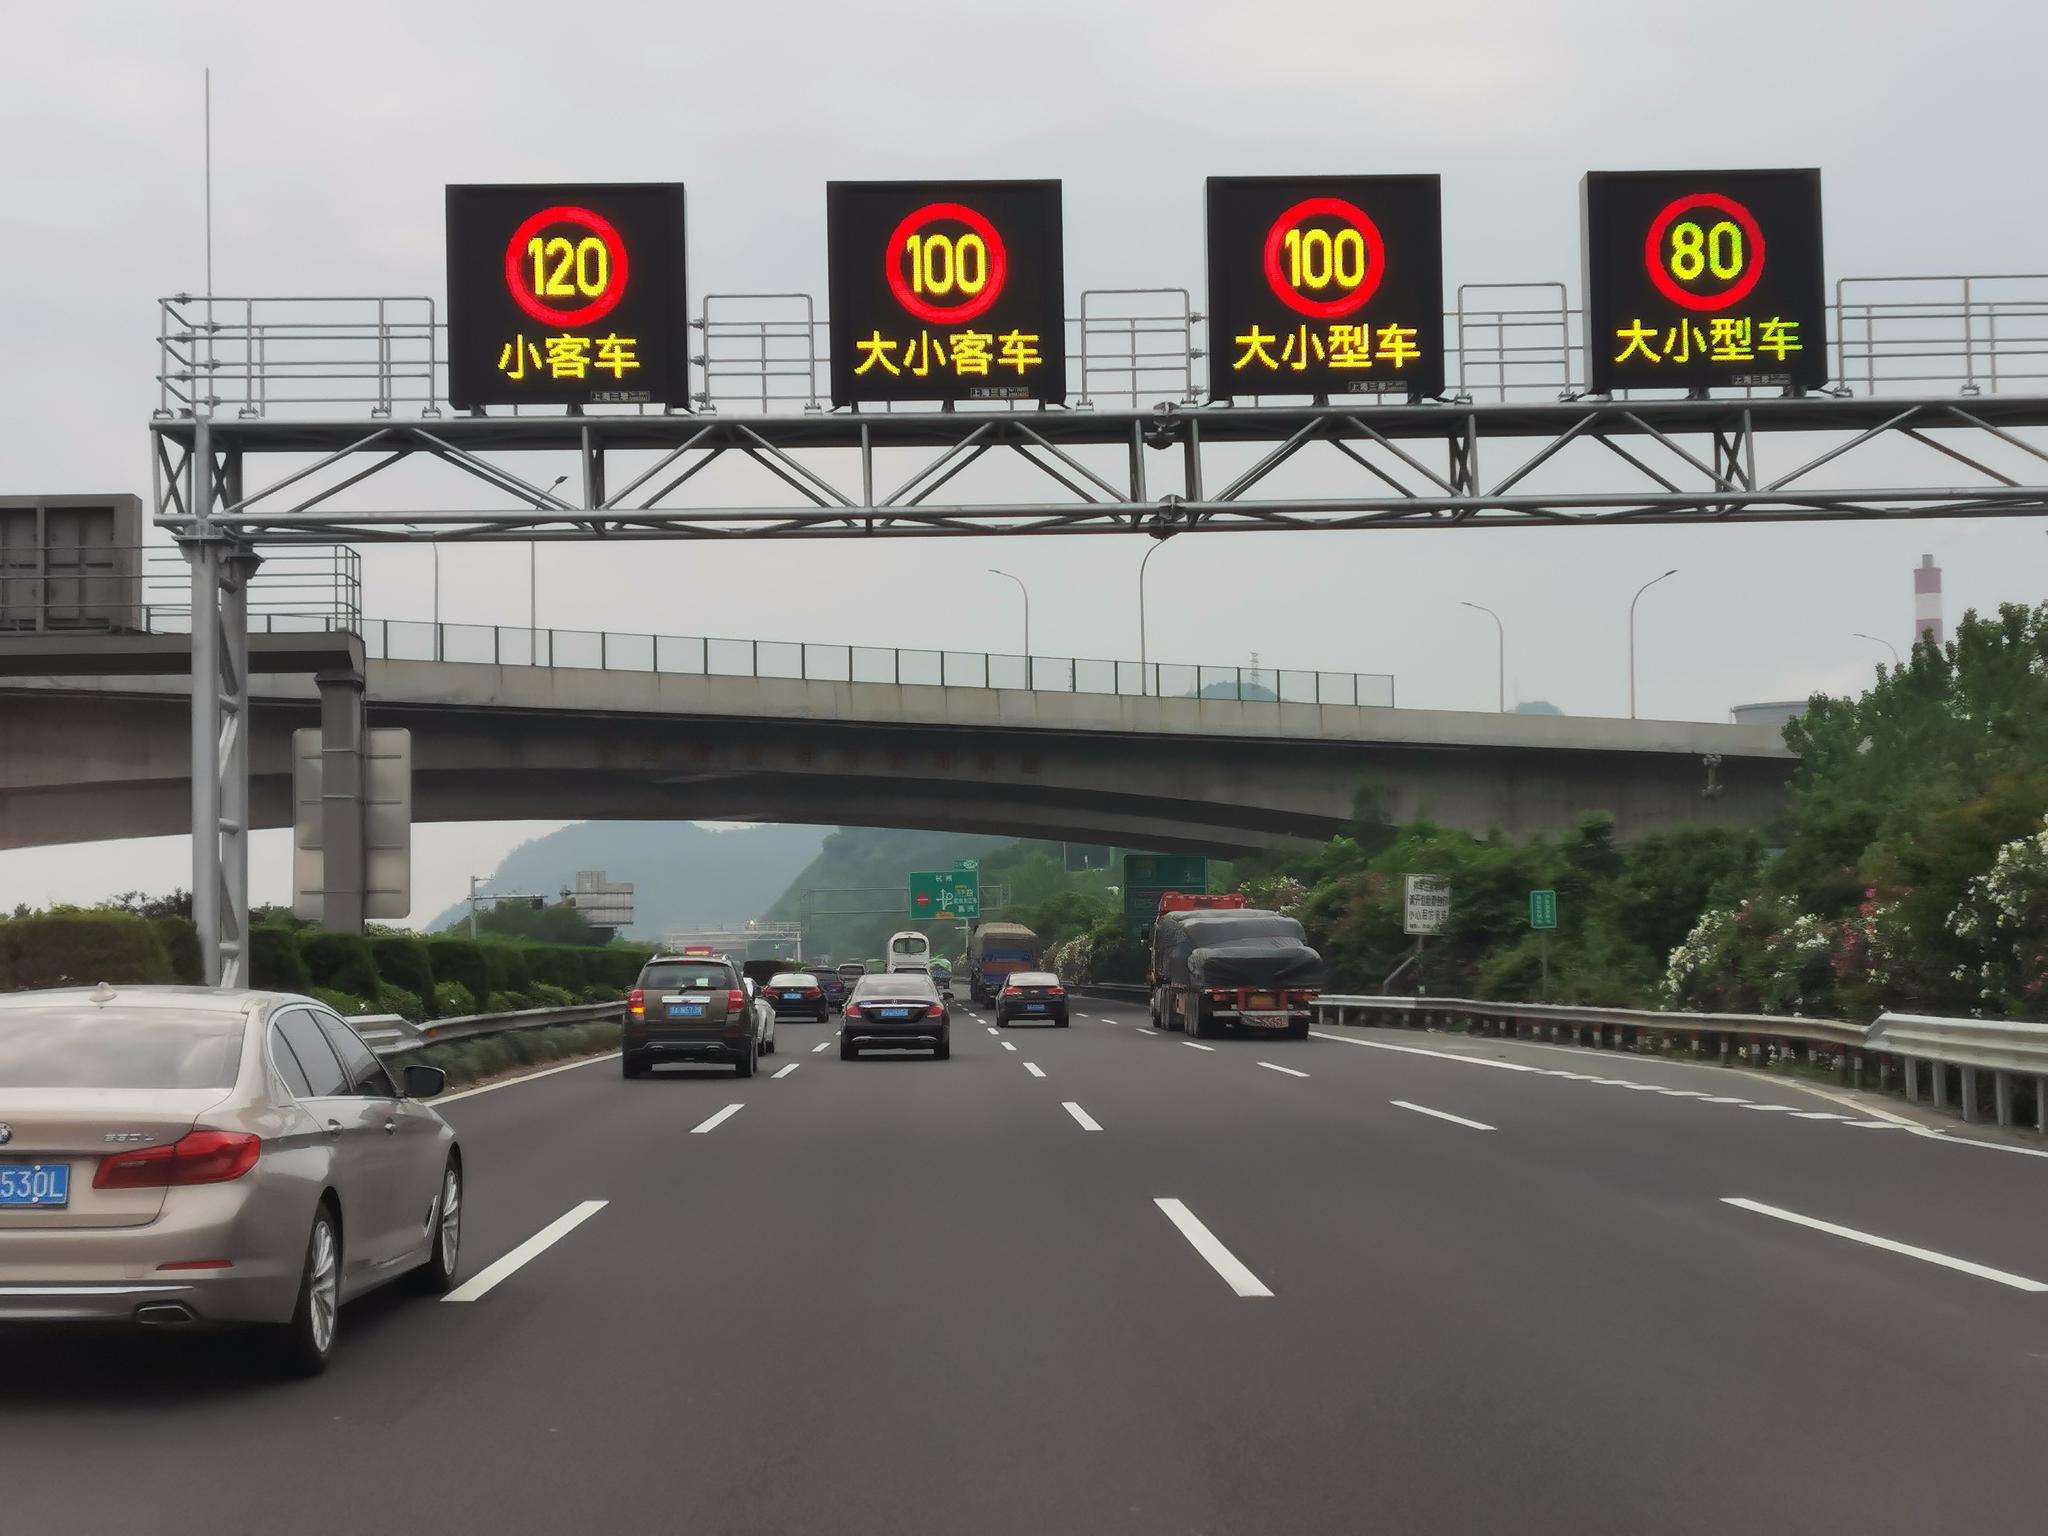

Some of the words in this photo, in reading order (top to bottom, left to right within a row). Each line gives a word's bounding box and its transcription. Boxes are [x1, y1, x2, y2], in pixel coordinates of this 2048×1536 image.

[528, 238, 607, 297] 120
[907, 234, 986, 294] 100
[1286, 229, 1364, 288] 100
[1671, 222, 1742, 280] 80
[498, 333, 640, 379] 小客车
[855, 330, 1042, 375] 大小客车
[1235, 324, 1420, 369] 大小型车
[1616, 317, 1802, 363] 大小型车
[1, 1170, 63, 1198] 530L
